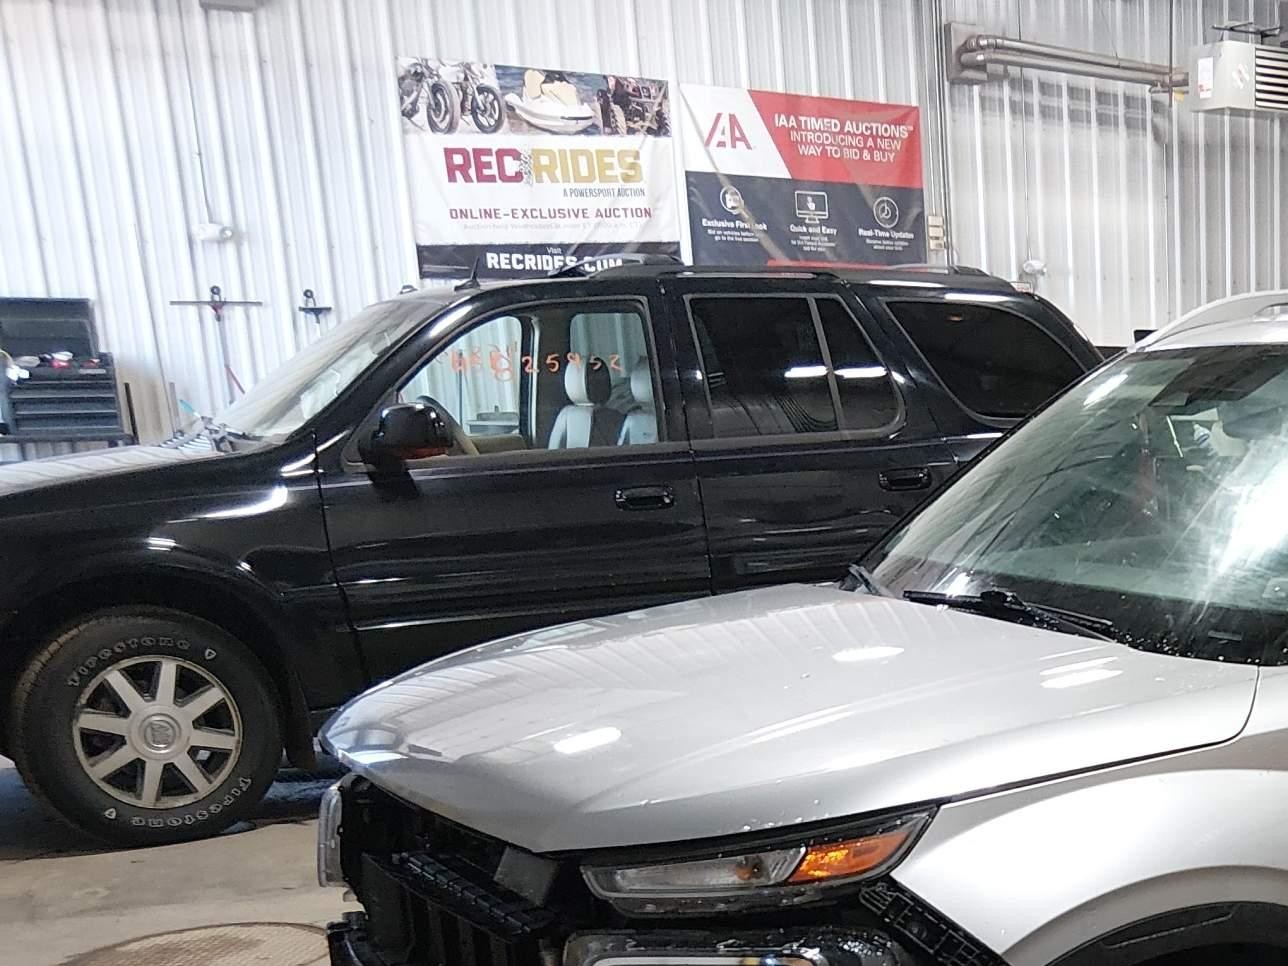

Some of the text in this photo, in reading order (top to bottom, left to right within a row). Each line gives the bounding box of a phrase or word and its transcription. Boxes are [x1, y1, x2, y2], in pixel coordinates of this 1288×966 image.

[774, 113, 798, 129] IAA
[798, 116, 841, 132] TIMED
[790, 131, 902, 151] INTRODUCING A NEW
[797, 143, 896, 163] WAY TO BID & BUY
[443, 147, 645, 184] REC RIDES
[569, 188, 616, 198] POWERSPORT
[617, 188, 646, 198] AUCTION
[450, 207, 653, 220] ONLINE-EXCLUSIVE AUCTION
[546, 246, 562, 255] Visit
